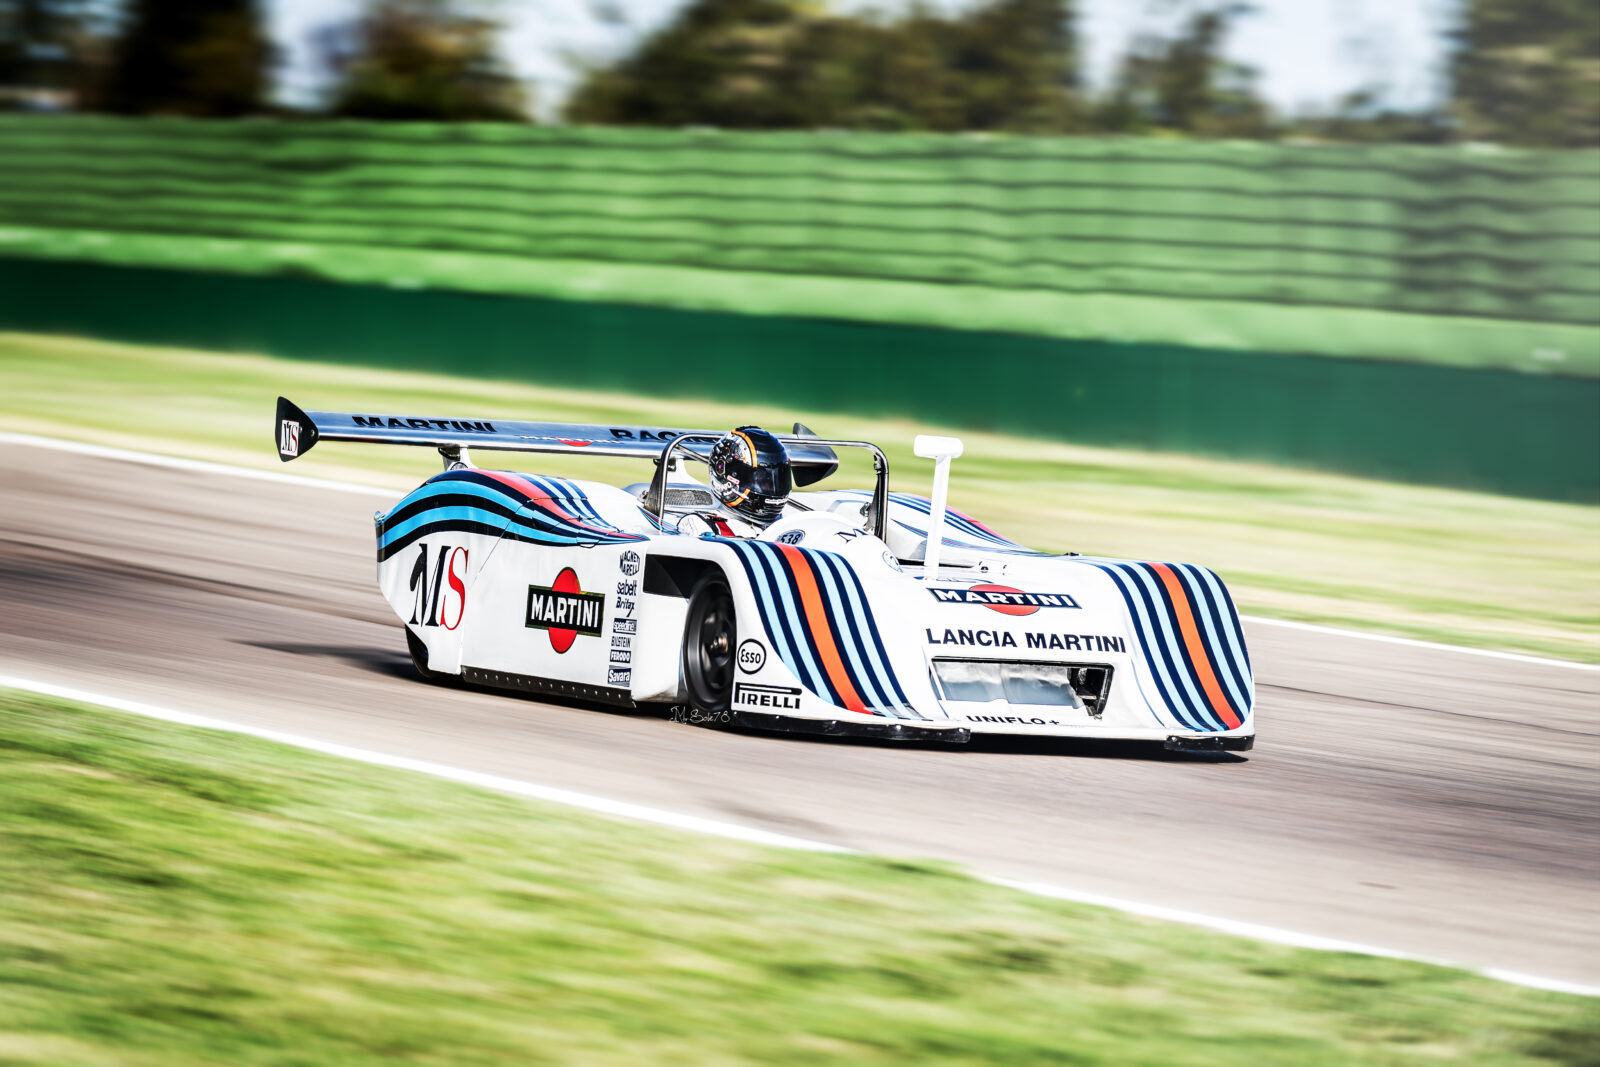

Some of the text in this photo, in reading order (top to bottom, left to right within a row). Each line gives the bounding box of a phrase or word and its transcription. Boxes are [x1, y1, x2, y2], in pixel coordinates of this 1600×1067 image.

[352, 416, 498, 433] MARTINI
[409, 543, 469, 630] MS
[616, 579, 637, 596] sabelt
[933, 589, 1074, 606] MARTINI
[531, 593, 600, 628] MARTINI
[926, 628, 1126, 653] LANCIA MARTINI
[734, 682, 802, 709] PIRELLI
